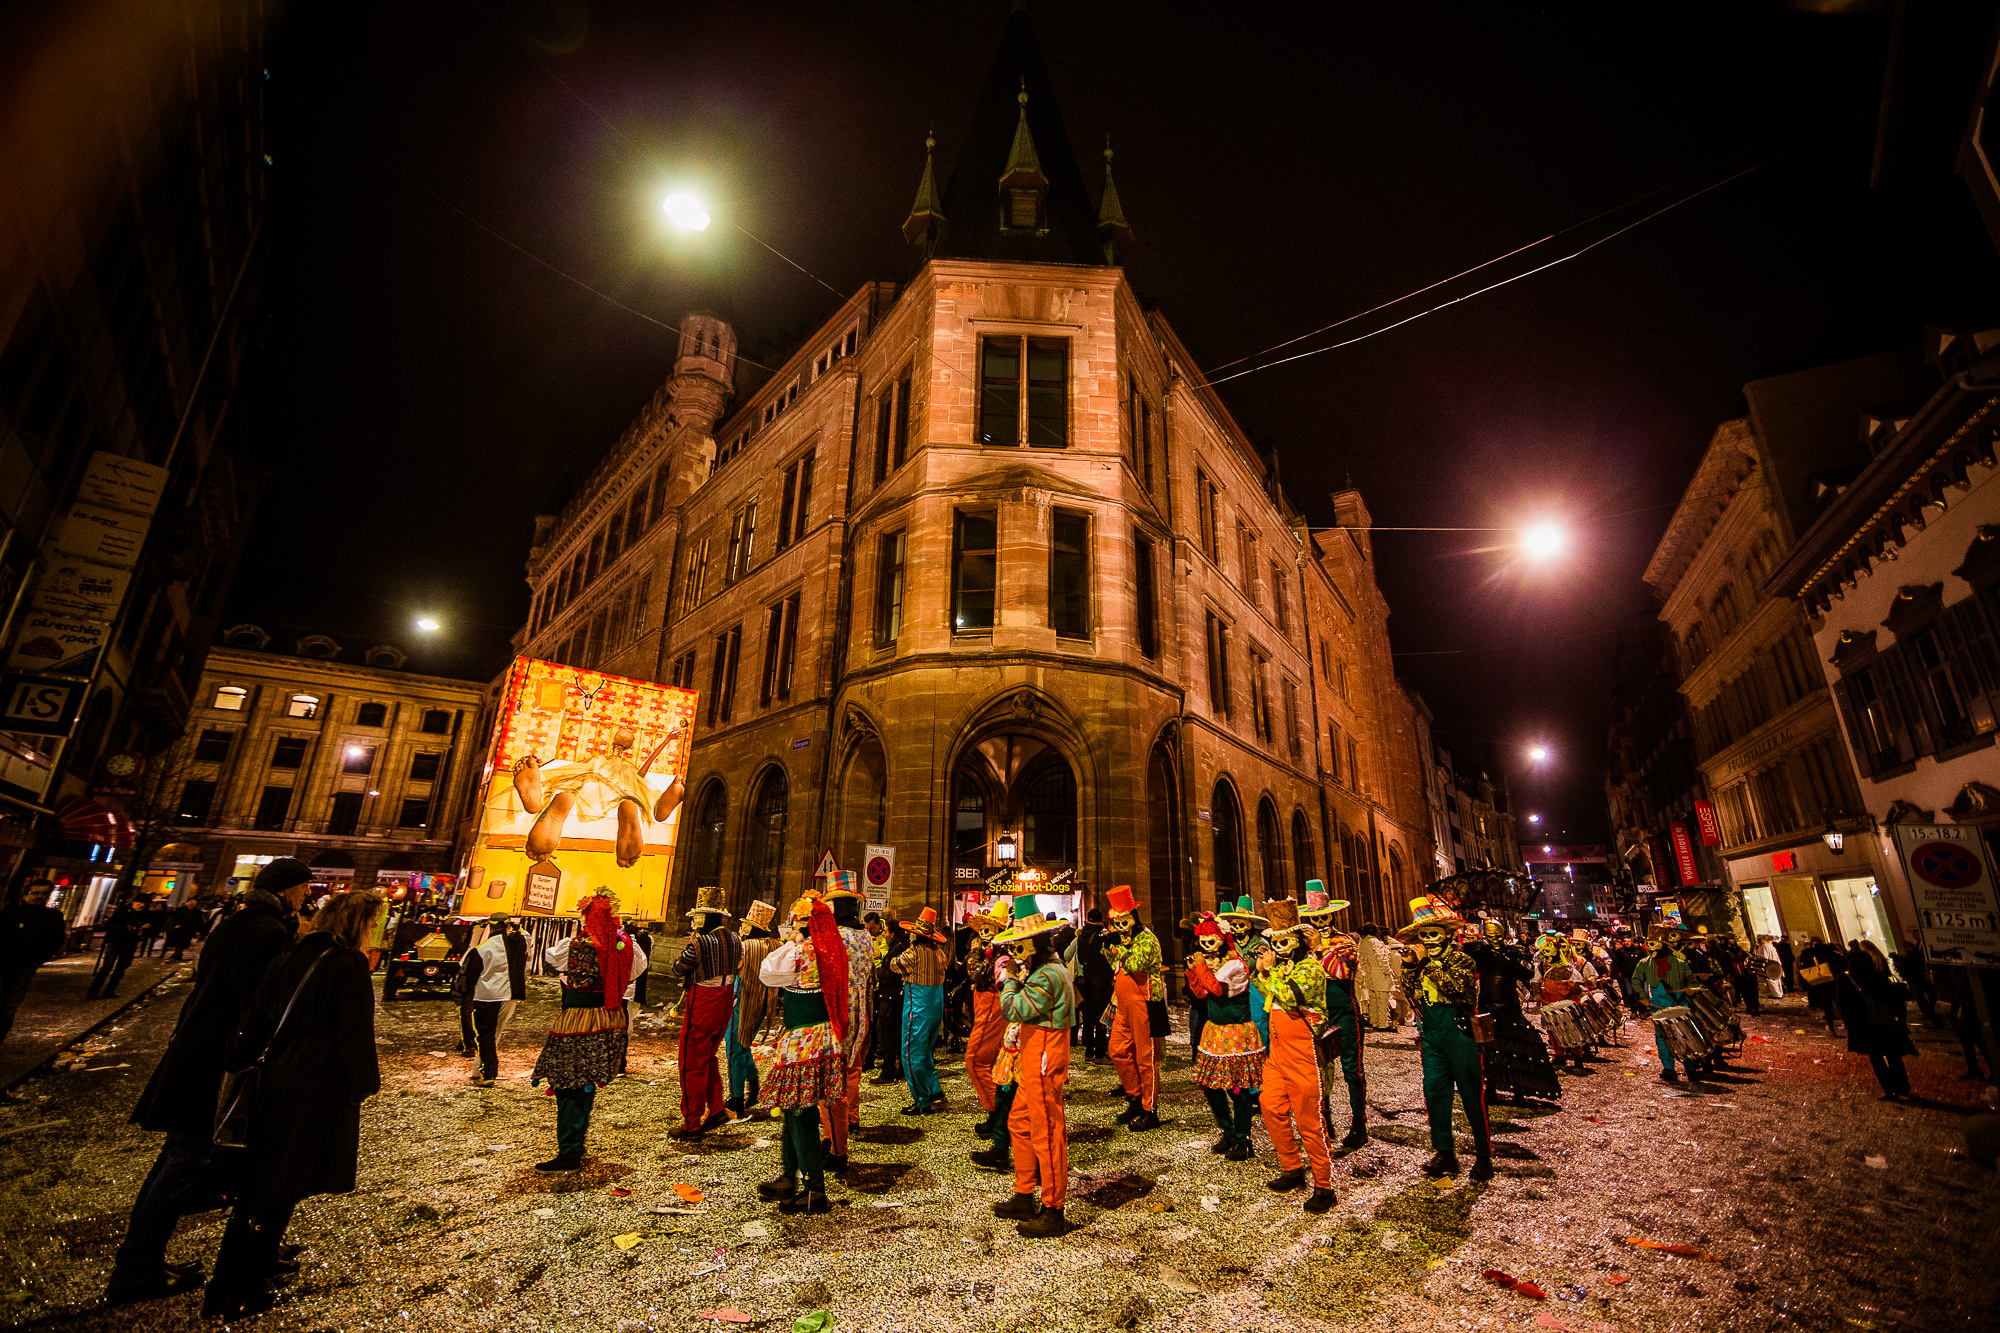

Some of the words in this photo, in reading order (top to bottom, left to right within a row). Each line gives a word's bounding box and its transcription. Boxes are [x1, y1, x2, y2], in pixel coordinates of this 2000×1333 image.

[58, 633, 99, 646] sport
[15, 686, 63, 718] I&S
[1699, 807, 1717, 839] ESPRIT
[1677, 834, 1688, 854] SHOES
[985, 868, 1008, 885] MERGUEZ
[1050, 868, 1074, 885] MERGUEZ
[1681, 855, 1694, 881] VÖGELE
[989, 882, 1023, 894] Spezial
[1025, 882, 1070, 894] Hot-Dogs
[1936, 913, 1966, 927] 125
[1969, 917, 1985, 928] m
